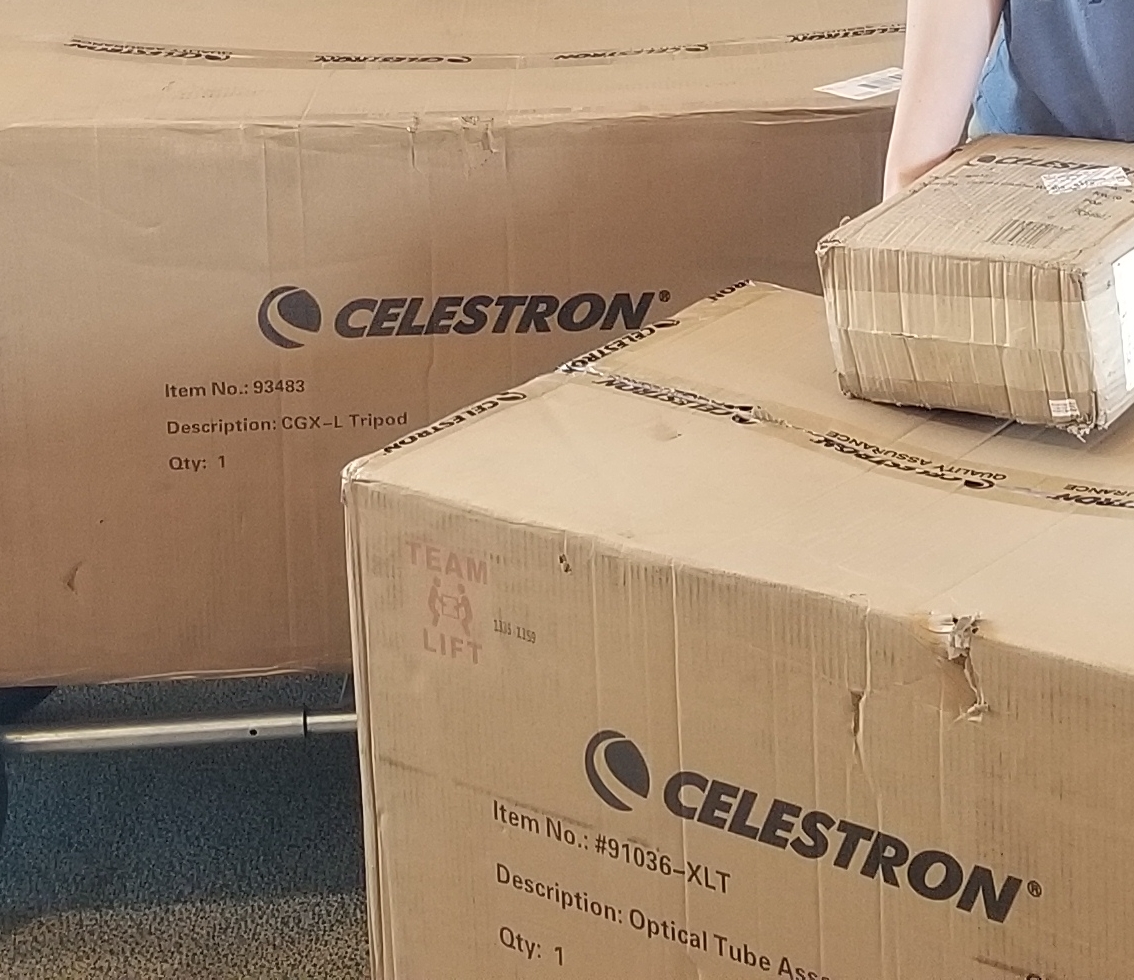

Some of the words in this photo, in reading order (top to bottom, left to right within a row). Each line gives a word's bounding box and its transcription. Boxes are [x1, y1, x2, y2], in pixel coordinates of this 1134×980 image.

[165, 383, 207, 399] Item
[211, 381, 249, 397] No.:
[253, 379, 305, 395] 93483
[167, 417, 278, 437] Description:
[349, 411, 408, 430] Tripod
[383, 400, 500, 456] CELESTRON
[168, 456, 207, 475] Qty:
[217, 455, 226, 469] 1
[825, 430, 932, 466] ASSURANCE
[933, 463, 1007, 481] QUALITY
[405, 539, 488, 585] TEAM
[422, 627, 483, 665] LIFT
[493, 799, 540, 835] Item
[545, 817, 589, 851] No.:
[496, 862, 623, 924] Description:
[629, 908, 708, 952] Optical
[713, 934, 771, 971] Tube
[498, 926, 542, 961] Qty:
[554, 946, 564, 966] 1
